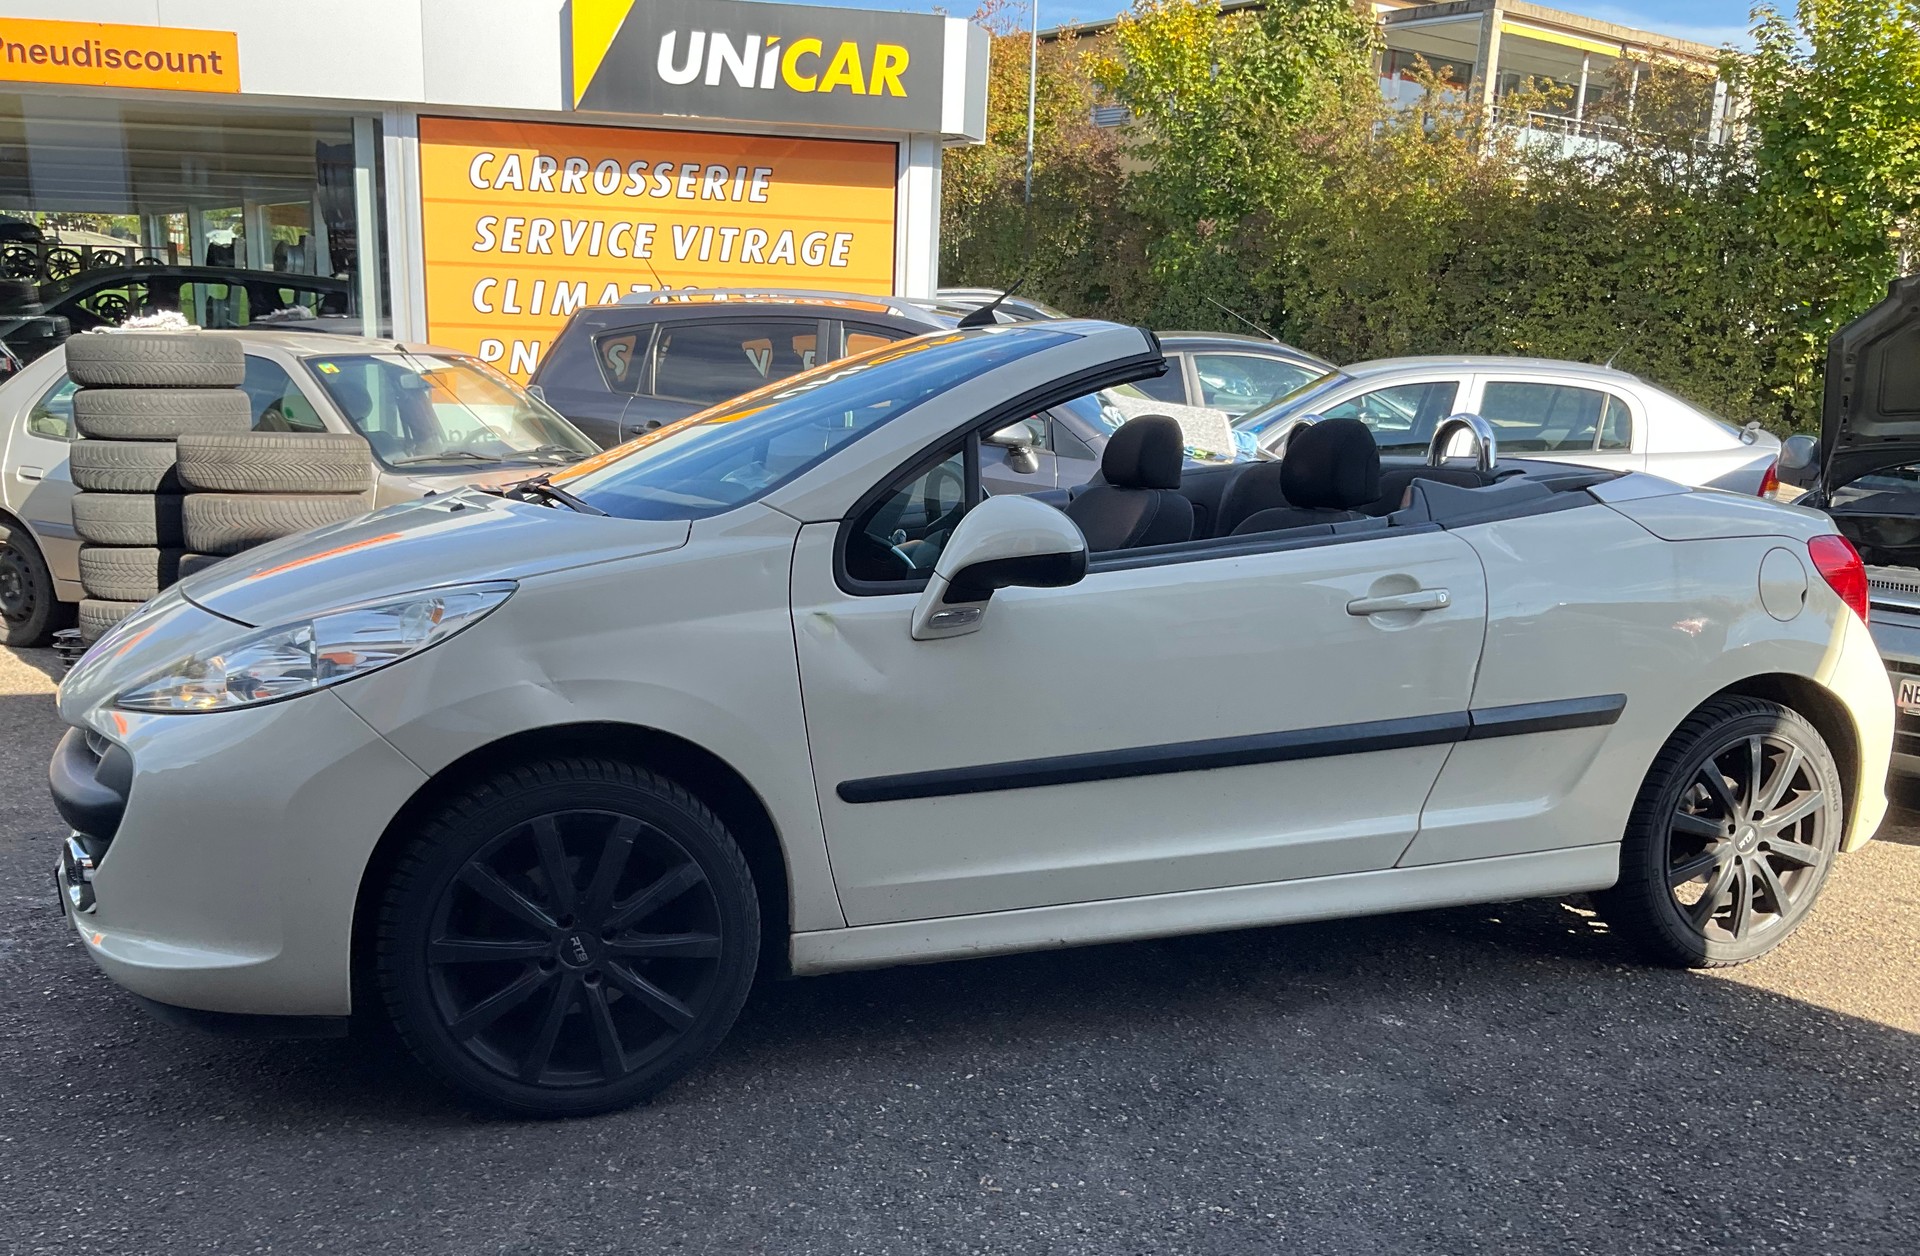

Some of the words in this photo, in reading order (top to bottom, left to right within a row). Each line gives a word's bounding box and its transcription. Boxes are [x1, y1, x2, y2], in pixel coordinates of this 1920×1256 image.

[0, 37, 223, 75] neudiscount
[469, 152, 774, 203] CARROSSERIE
[472, 215, 657, 259] SERVICE
[671, 224, 854, 267] VITRAGE
